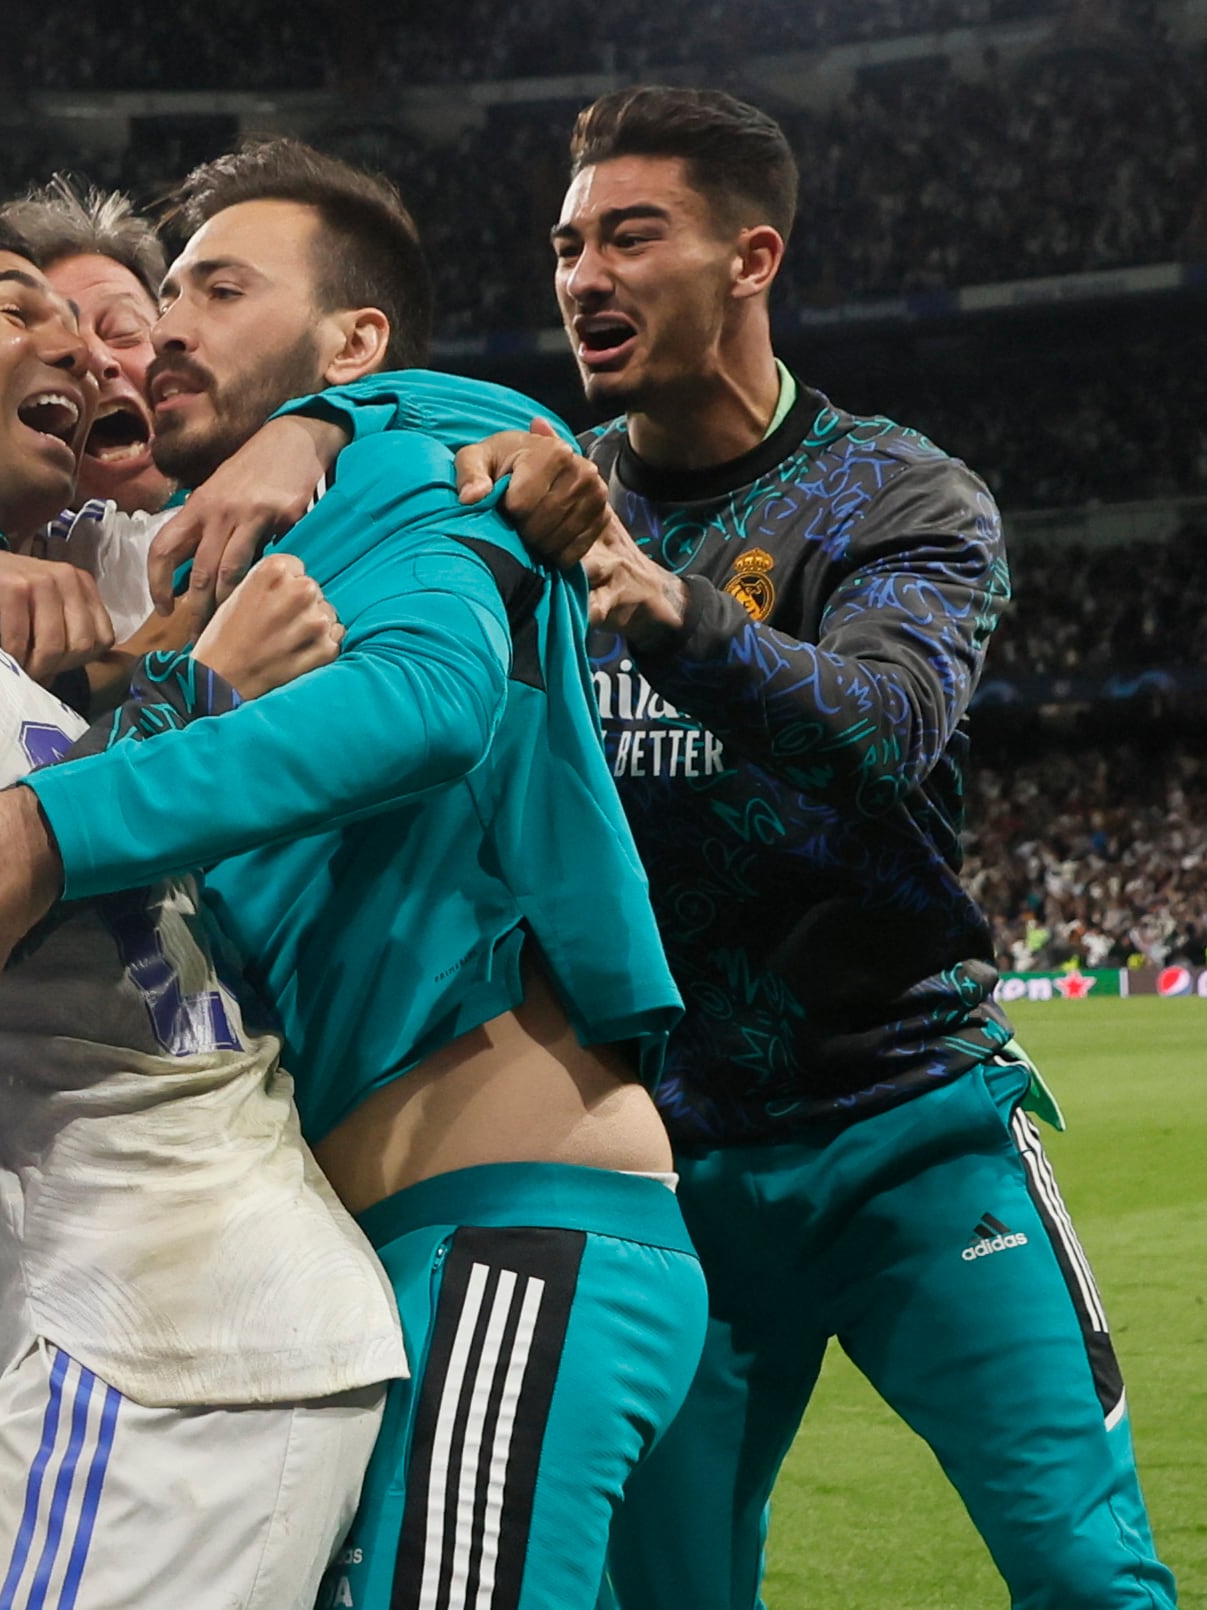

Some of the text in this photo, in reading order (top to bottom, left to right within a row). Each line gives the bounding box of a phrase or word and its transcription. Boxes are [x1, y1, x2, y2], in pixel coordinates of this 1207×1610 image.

[614, 730, 725, 778] BETTER
[994, 976, 1053, 1001] en
[961, 1232, 1029, 1261] adidas
